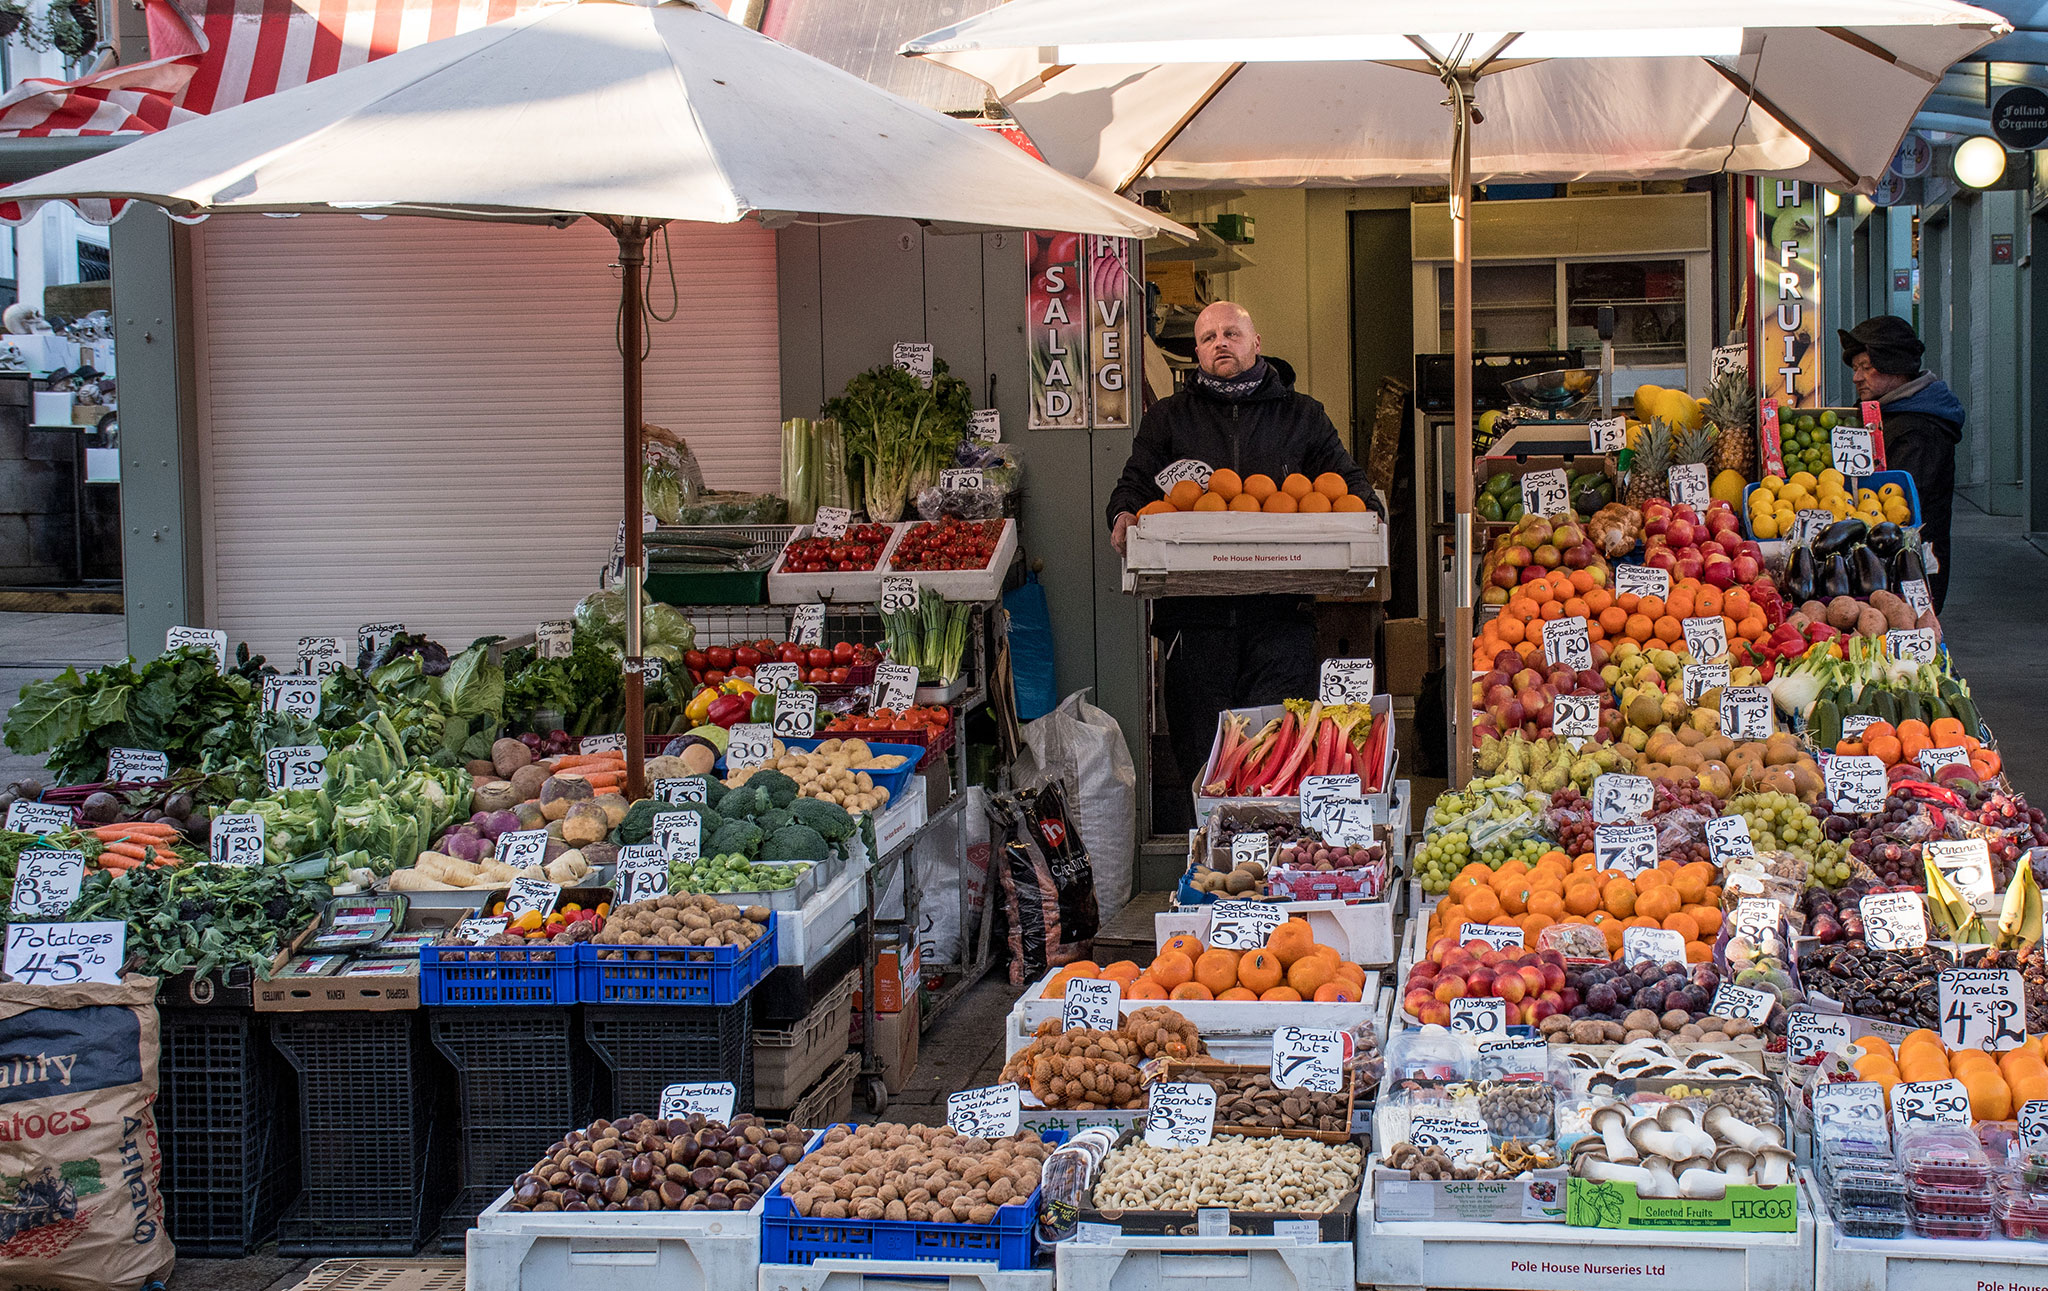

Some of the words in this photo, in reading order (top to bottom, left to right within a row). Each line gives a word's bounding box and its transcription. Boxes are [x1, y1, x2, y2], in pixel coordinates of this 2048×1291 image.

[2002, 105, 2045, 118] Folland
[1999, 117, 2048, 131] Organics
[1776, 239, 1803, 394] FRUIT
[1042, 266, 1073, 418] SALAD
[1097, 299, 1124, 391] VEG
[1833, 427, 1868, 436] Lemons
[1833, 442, 1862, 450] Limes
[1836, 451, 1871, 472] 40
[1670, 464, 1693, 474] Pink
[1524, 472, 1556, 482] Local
[1212, 554, 1229, 562] Pole
[1230, 554, 1253, 562] House
[1255, 554, 1289, 562] Nurseries
[1290, 554, 1302, 562] Ltd
[1617, 564, 1661, 575] Seedless
[883, 576, 913, 588] Spring
[883, 593, 916, 609] 80
[1545, 617, 1576, 631] Local
[1683, 617, 1723, 628] Williams
[169, 630, 216, 639] Local
[297, 637, 336, 650] Spring
[756, 663, 799, 677] Peppers
[877, 664, 912, 674] Salad
[1327, 659, 1374, 670] Rhubarb
[1686, 663, 1730, 674] Comice
[876, 673, 909, 682] Toms
[1689, 671, 1728, 681] Pears
[777, 690, 815, 704] Baking
[1722, 686, 1757, 696] Local
[1723, 693, 1768, 704] Russets
[1554, 702, 1591, 726] 90
[775, 711, 813, 732] 60
[111, 748, 162, 761] Bunched
[1829, 758, 1872, 771] Italia
[1307, 776, 1361, 786] Cherries
[1834, 768, 1883, 782] Grapes
[1608, 776, 1651, 789] Grapes
[14, 803, 71, 818] Bunched
[656, 811, 695, 823] Local
[220, 815, 255, 825] Local
[654, 820, 698, 832] Sprouts
[1707, 818, 1736, 835] Figs
[224, 824, 258, 833] Leeks
[1596, 825, 1655, 836] Seedless
[1232, 834, 1268, 844] Kiwis
[1600, 834, 1657, 844] Satsumas
[621, 847, 664, 860] Italian
[1927, 842, 1987, 856] Bananas
[20, 850, 83, 869] Sprouting
[1600, 847, 1627, 870] 7
[28, 865, 69, 878] Broc
[514, 876, 553, 889] Sweet
[1212, 900, 1279, 913] Seedless
[1738, 897, 1776, 910] Fresh
[1863, 896, 1907, 908] Fresh
[1215, 910, 1281, 922] Satsumas
[1869, 904, 1915, 916] Dates
[1739, 908, 1769, 926] Figs
[11, 926, 113, 949] Potatoes
[1212, 922, 1239, 946] 5
[1630, 926, 1675, 940] Plums
[1940, 968, 2010, 990] Spanish
[1067, 978, 1112, 994] Mixed
[1720, 982, 1764, 1003] Brown
[1089, 1014, 1114, 1031] Bag
[1451, 1011, 1499, 1032] 50
[1789, 1011, 1818, 1025] Red
[1944, 999, 1973, 1045] 4
[1282, 1025, 1340, 1043] Brazil
[1791, 1022, 1846, 1037] Currants
[1870, 1022, 1896, 1033] Soft
[1478, 1038, 1548, 1054] Cranberries
[1305, 1062, 1340, 1076] Pound
[664, 1083, 733, 1097] Chestnuts
[1153, 1082, 1188, 1095] Red
[1903, 1081, 1953, 1101] Rasps
[956, 1096, 1009, 1112] Walnuts
[1153, 1094, 1213, 1107] Peanuts
[979, 1110, 1012, 1120] Pound
[1173, 1113, 1208, 1124] Pound
[1023, 1116, 1070, 1134] Soft
[1411, 1117, 1481, 1129] Assorted
[1418, 1124, 1488, 1135] Mushrooms
[1443, 1183, 1474, 1194] Soft
[1477, 1183, 1508, 1194] fruit
[1645, 1206, 1684, 1219] Selected
[1686, 1206, 1713, 1219] Fruits
[1731, 1199, 1792, 1219] FIGOS
[1510, 1260, 1537, 1273] Pole
[1541, 1261, 1580, 1275] House
[1583, 1261, 1642, 1276] Nurseries
[1645, 1263, 1666, 1277] Ltd
[1976, 1280, 2005, 1291] Pole
